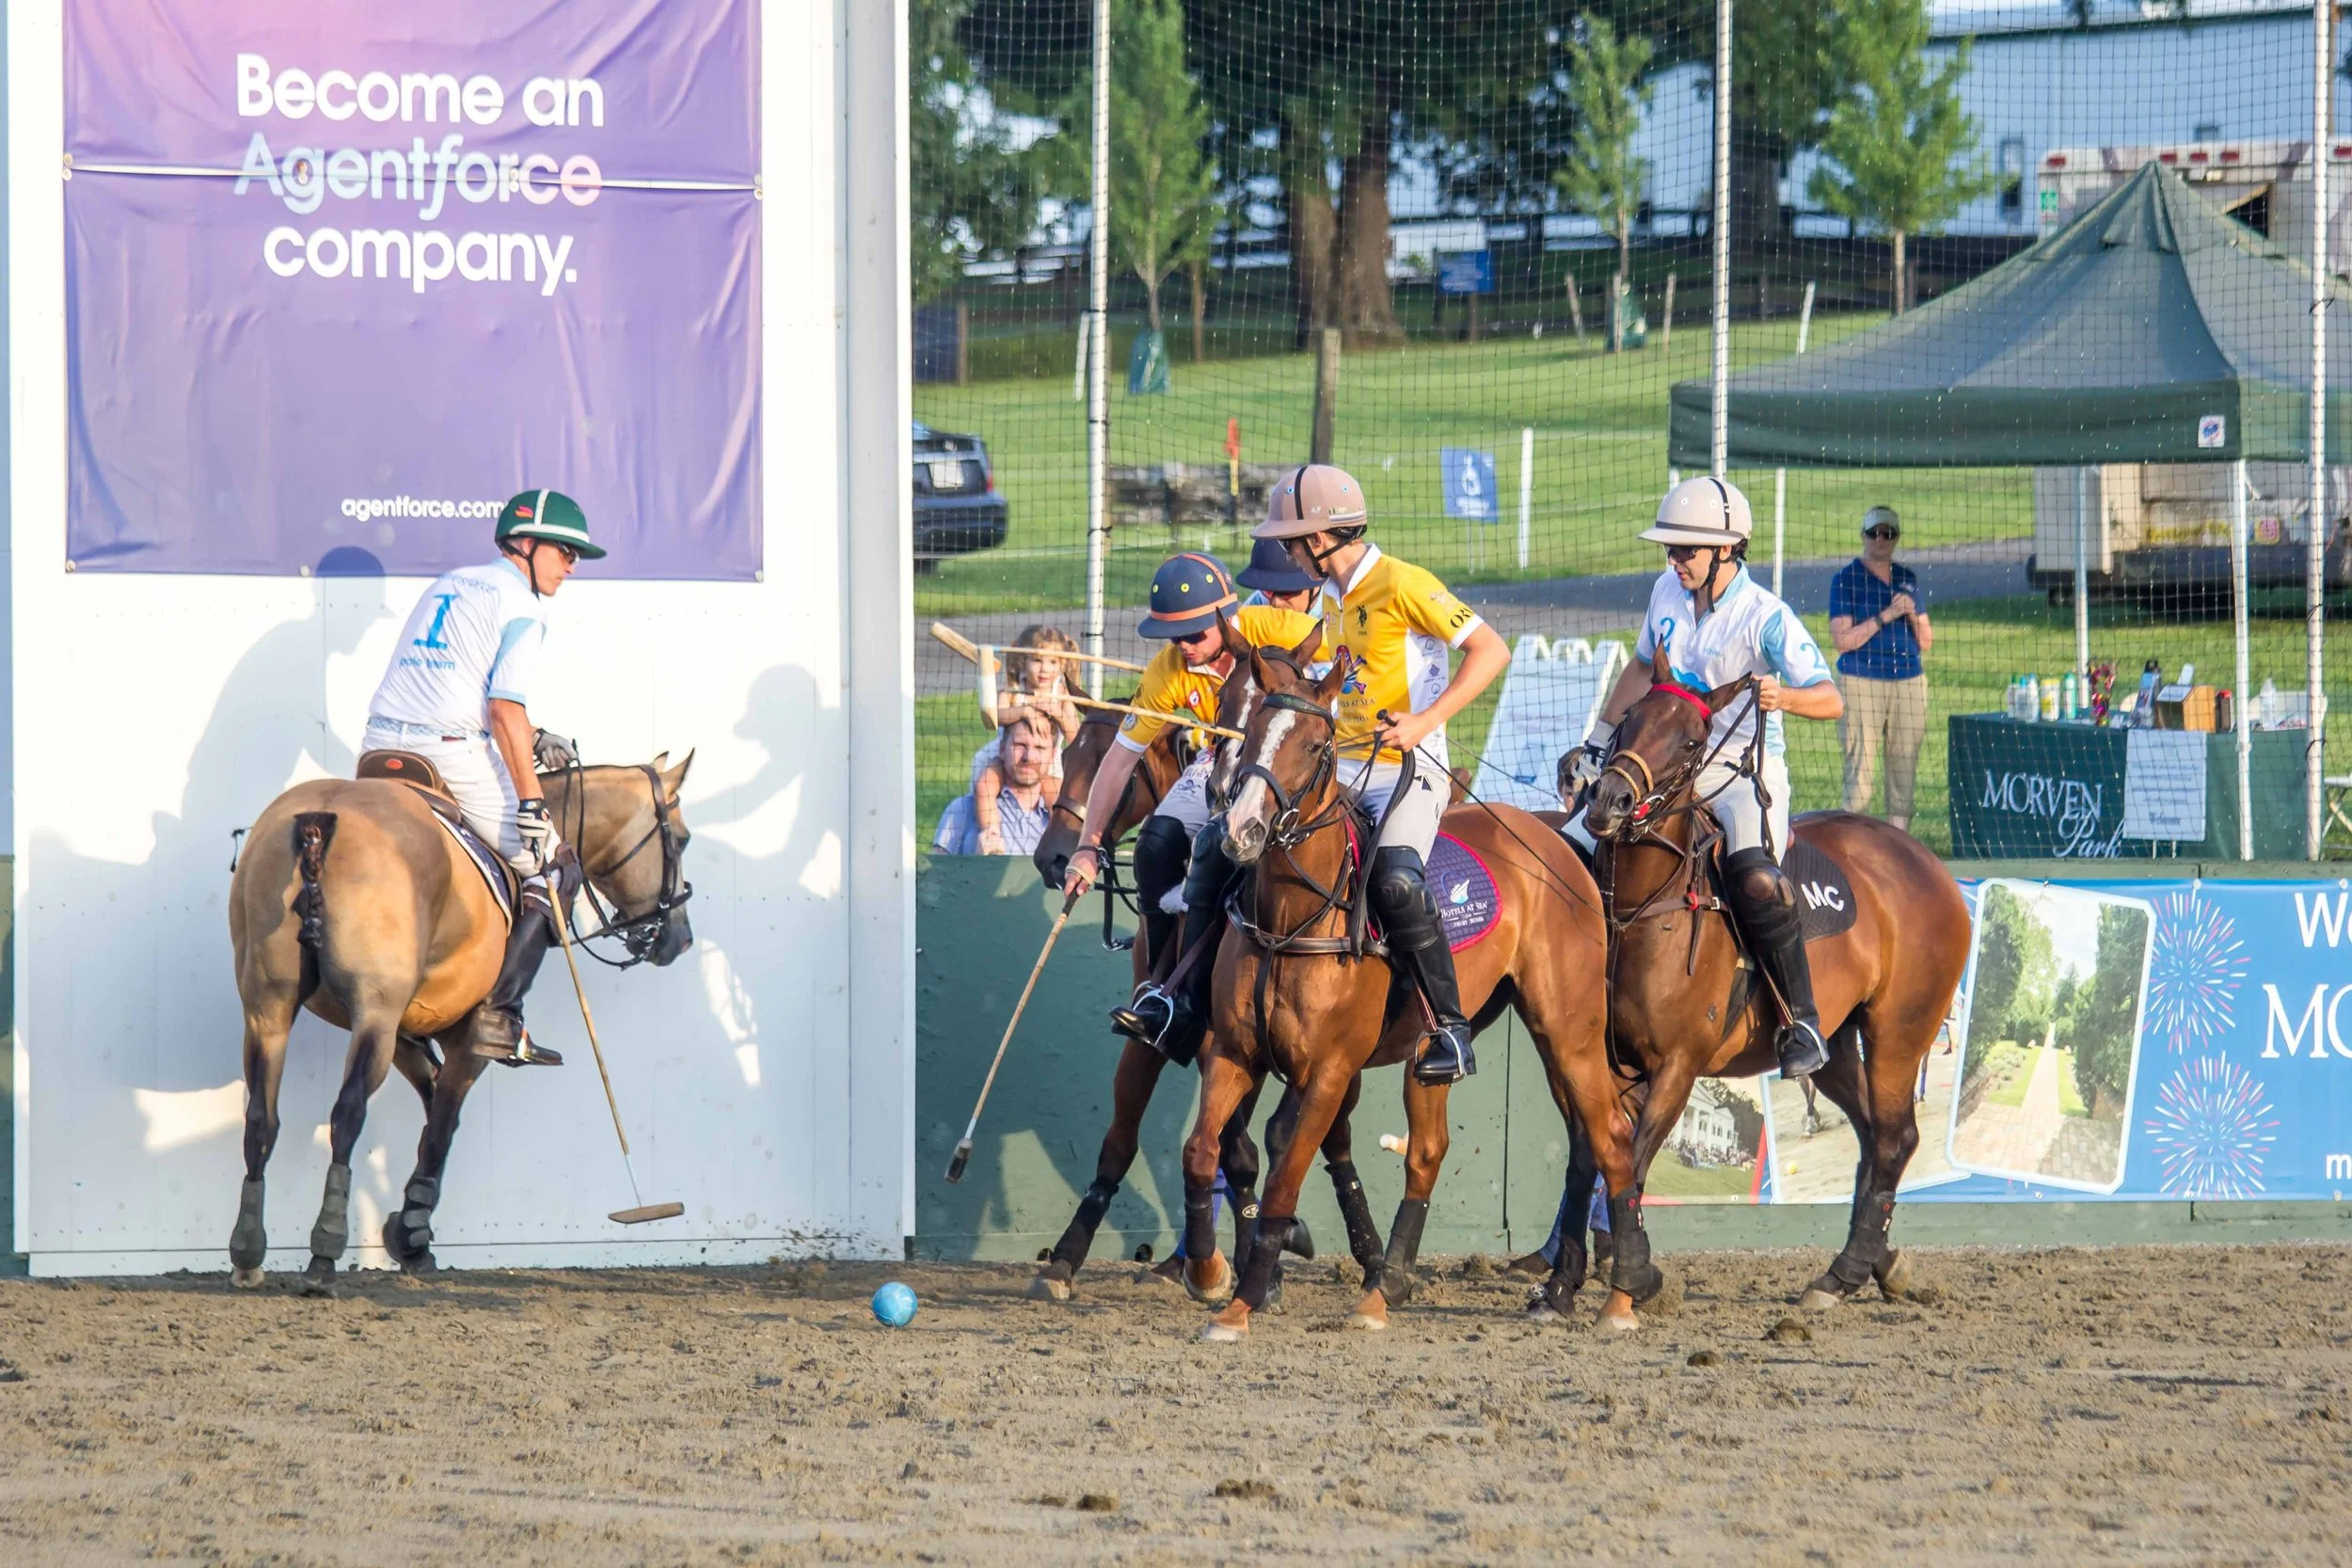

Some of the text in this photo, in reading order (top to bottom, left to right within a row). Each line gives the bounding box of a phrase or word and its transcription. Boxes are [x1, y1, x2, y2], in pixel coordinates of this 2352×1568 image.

[237, 54, 604, 127] Become an
[234, 132, 602, 221] Agentforce
[263, 226, 578, 296] company.
[341, 495, 505, 522] agentforce.com
[1660, 617, 1676, 653] 2
[1800, 642, 1828, 670] 2
[1982, 769, 2103, 821] MORVEN
[2053, 810, 2125, 858] Park
[1801, 880, 1844, 911] MC
[2294, 892, 2352, 948] W
